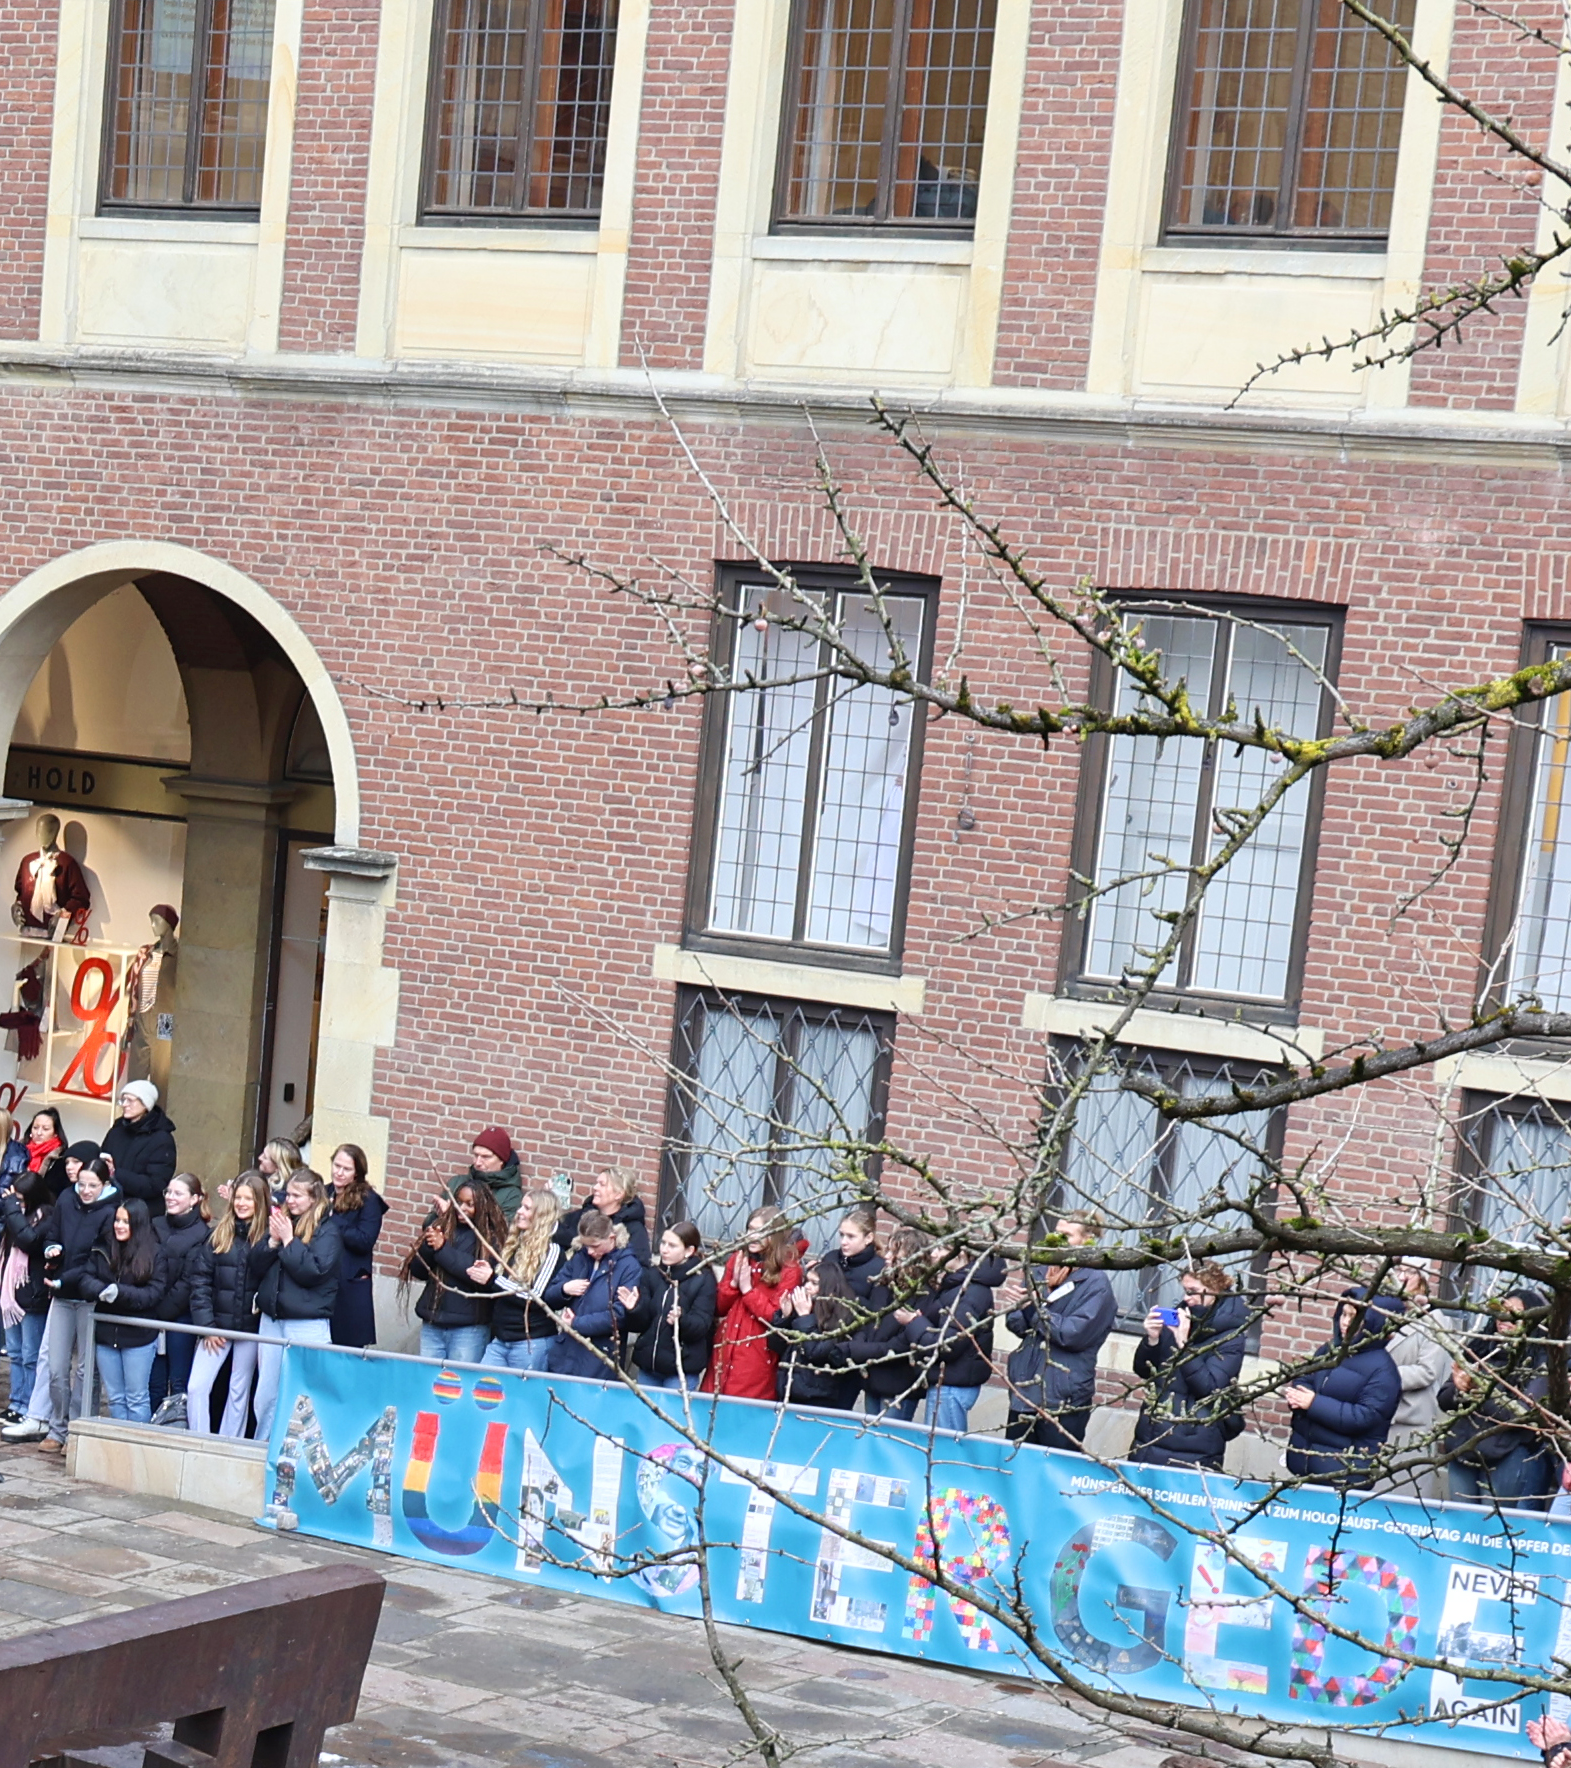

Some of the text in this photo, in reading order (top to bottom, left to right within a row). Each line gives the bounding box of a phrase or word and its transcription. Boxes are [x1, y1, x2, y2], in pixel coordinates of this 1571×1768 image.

[28, 766, 95, 795] HOLD
[51, 957, 128, 1104] %
[1155, 1489, 1207, 1507] SCHULEN
[1272, 1505, 1300, 1520] ZUM
[1463, 1532, 1480, 1546] AN
[1482, 1535, 1503, 1549] DIE
[1506, 1537, 1550, 1553] OPFER
[1551, 1542, 1571, 1556] DE
[272, 1370, 1011, 1652] MÜNSTER
[1050, 1514, 1571, 1733] GEDE
[1452, 1571, 1537, 1600] NEVER
[1433, 1697, 1516, 1727] AGAIN
